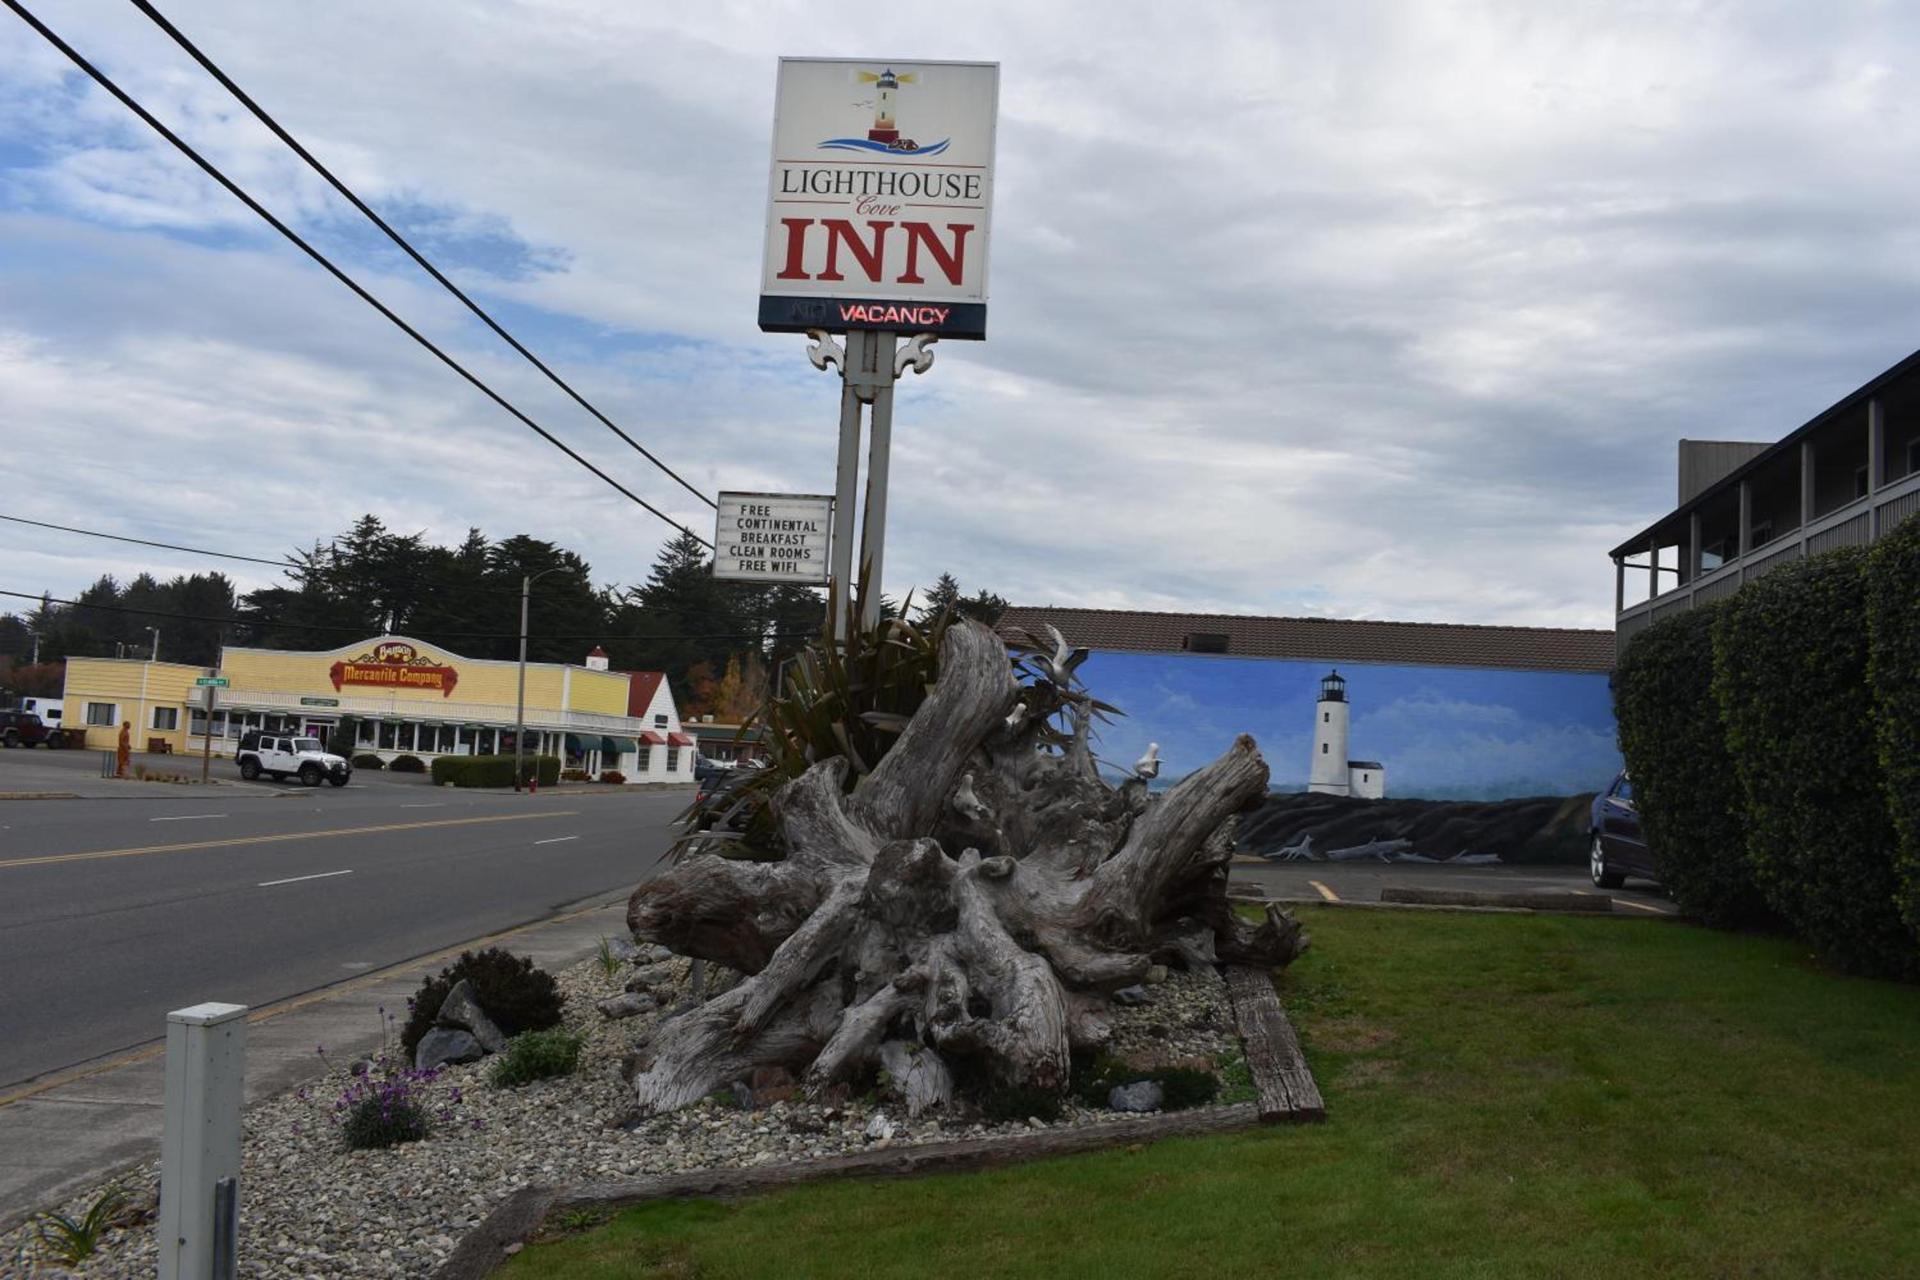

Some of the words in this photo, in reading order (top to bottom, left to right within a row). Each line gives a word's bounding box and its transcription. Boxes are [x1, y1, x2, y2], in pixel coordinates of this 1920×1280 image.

[780, 169, 982, 200] LIGHTHOUSE
[856, 195, 901, 216] Cove
[776, 217, 975, 286] INN
[839, 304, 950, 325] VACANCY
[740, 505, 771, 517] FREE
[736, 518, 818, 532] CONTINENTAL
[740, 532, 807, 546] BREAKFAST
[729, 545, 765, 558] CLEAN
[770, 548, 812, 560] ROOMS
[739, 560, 767, 572] FREE
[771, 561, 798, 573] WIFI
[343, 665, 398, 682] Mercantile
[399, 668, 444, 688] Company
